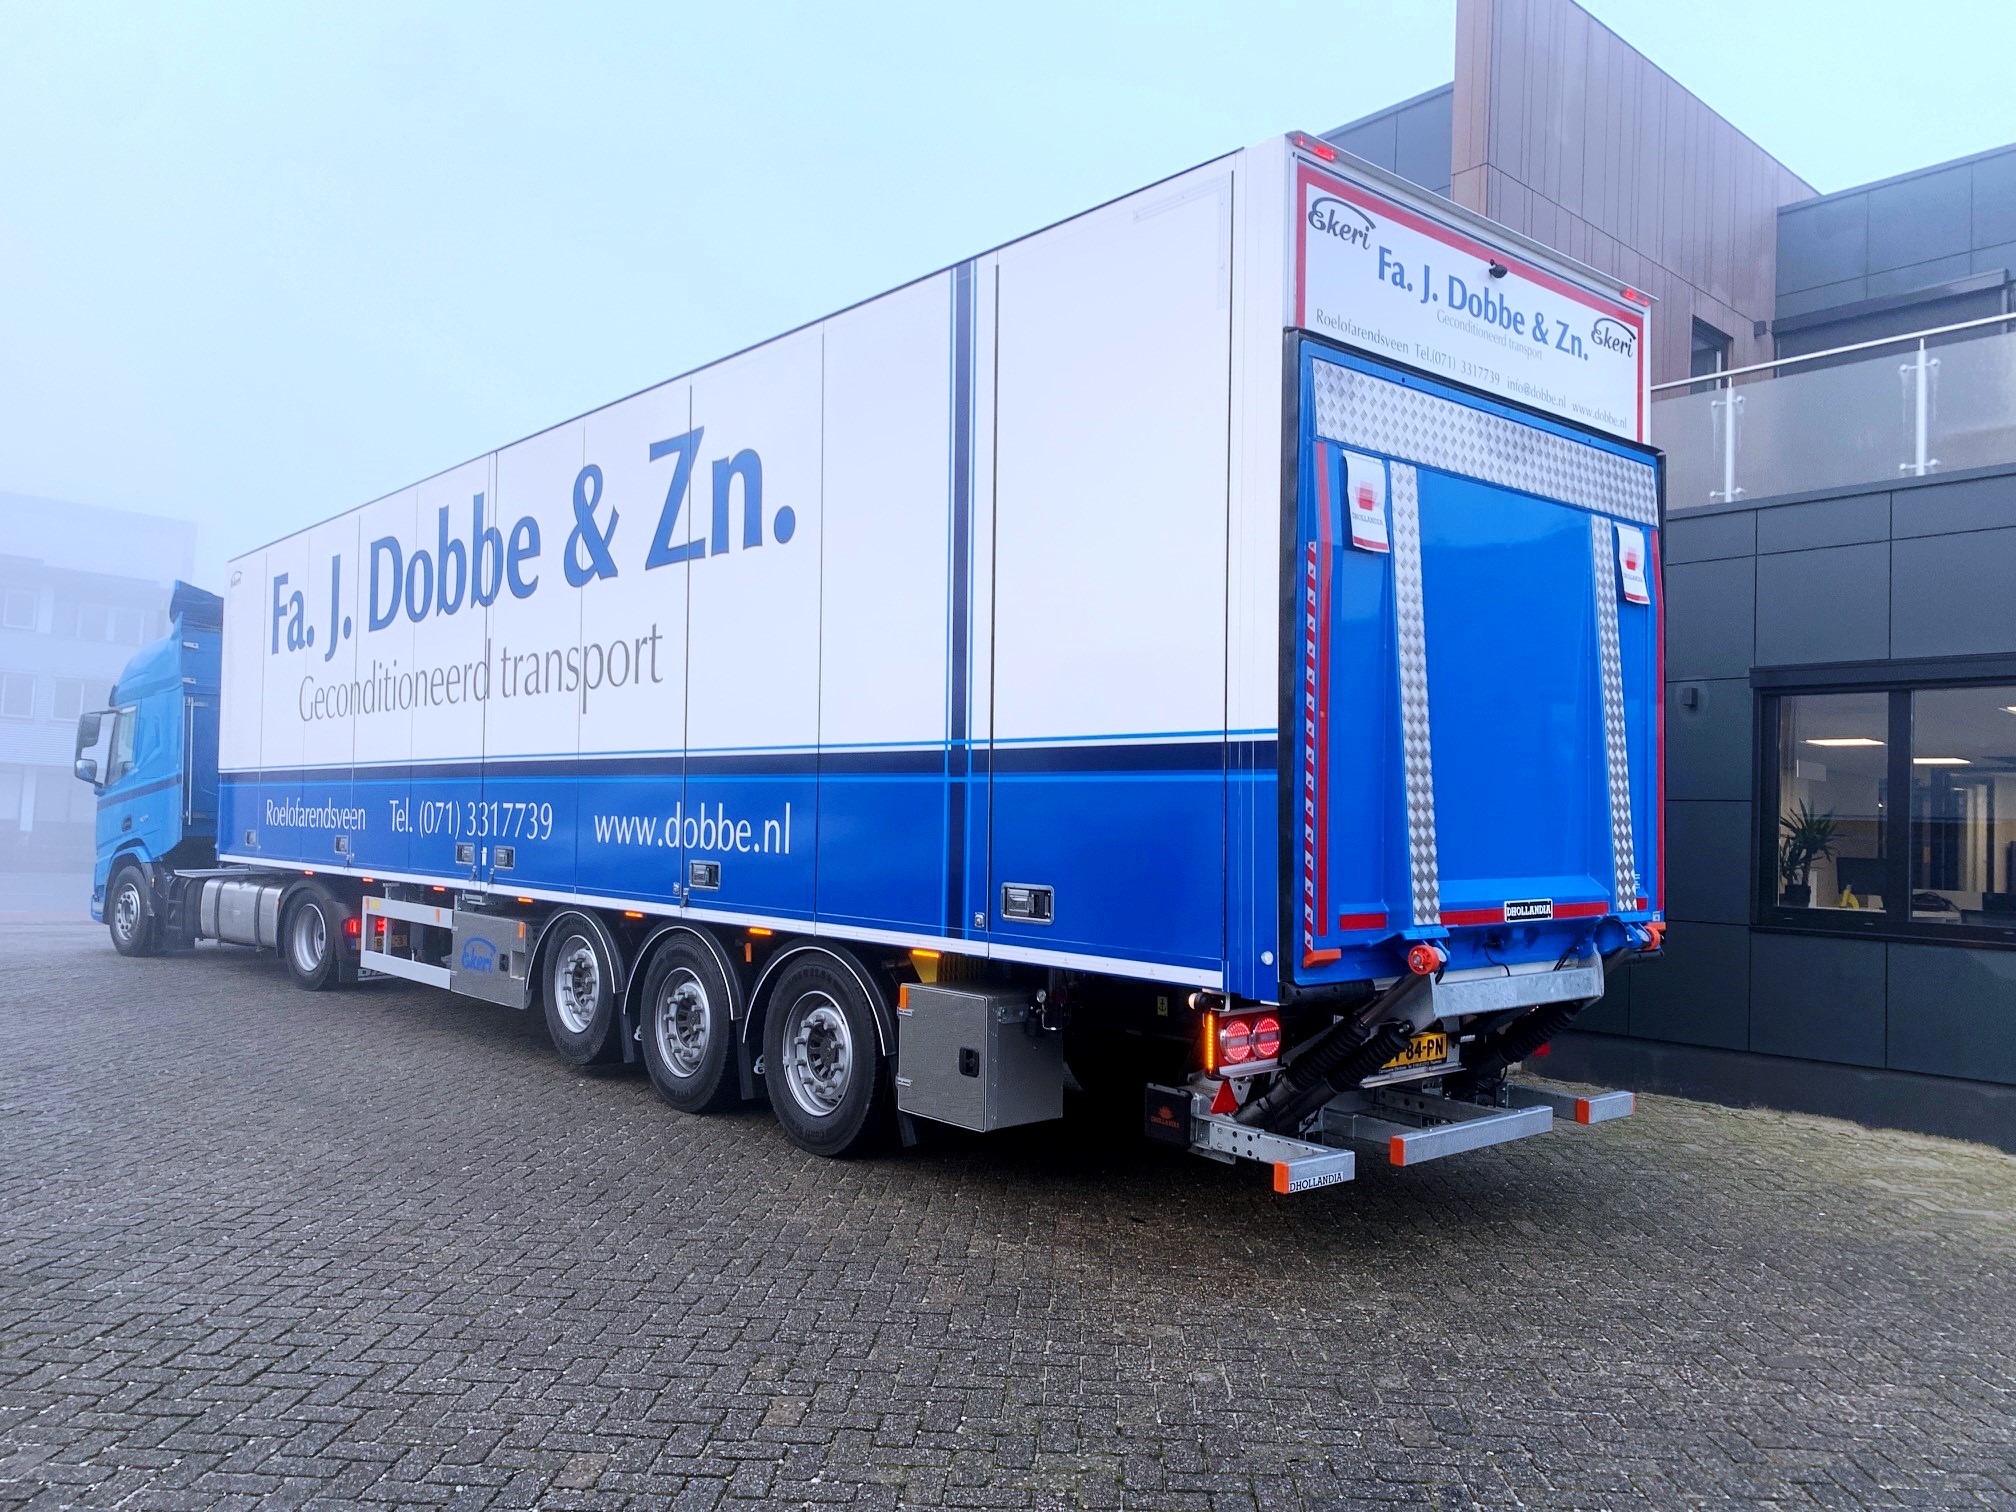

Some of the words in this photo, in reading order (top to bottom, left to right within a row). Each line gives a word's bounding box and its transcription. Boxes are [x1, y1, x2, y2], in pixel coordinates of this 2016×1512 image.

[1308, 197, 1376, 250] Ekeri
[1379, 245, 1413, 292] Fa.
[1420, 264, 1438, 304] J.
[1448, 274, 1525, 335] Dobbe
[1532, 312, 1549, 346] &
[1555, 319, 1589, 361] Zn.
[1437, 308, 1507, 346] Geconditioneerd
[1508, 337, 1543, 360] transport
[1591, 318, 1636, 358] Ekeri
[1316, 308, 1409, 354] Roelofarendsveen
[1460, 360, 1500, 385] 3317739
[1507, 376, 1567, 409] info@dobbe.nl
[1572, 402, 1627, 429] www.dobbe.nl
[271, 573, 315, 655] Fa.
[324, 554, 353, 663] J.
[368, 491, 541, 633] Dobbe
[563, 463, 620, 588] &
[645, 426, 796, 571] Zn.
[299, 638, 491, 722] Geconditioneerd
[500, 623, 663, 714] transport
[266, 798, 366, 832] Roelofarendsveen
[389, 798, 414, 834] Tel.
[418, 801, 462, 838] (071)
[466, 801, 553, 840] 3317739
[594, 802, 791, 855] www.dobbe.nl
[1506, 905, 1551, 916] DHOLLANDIA
[1289, 1172, 1343, 1192] DHOLLANDIA
